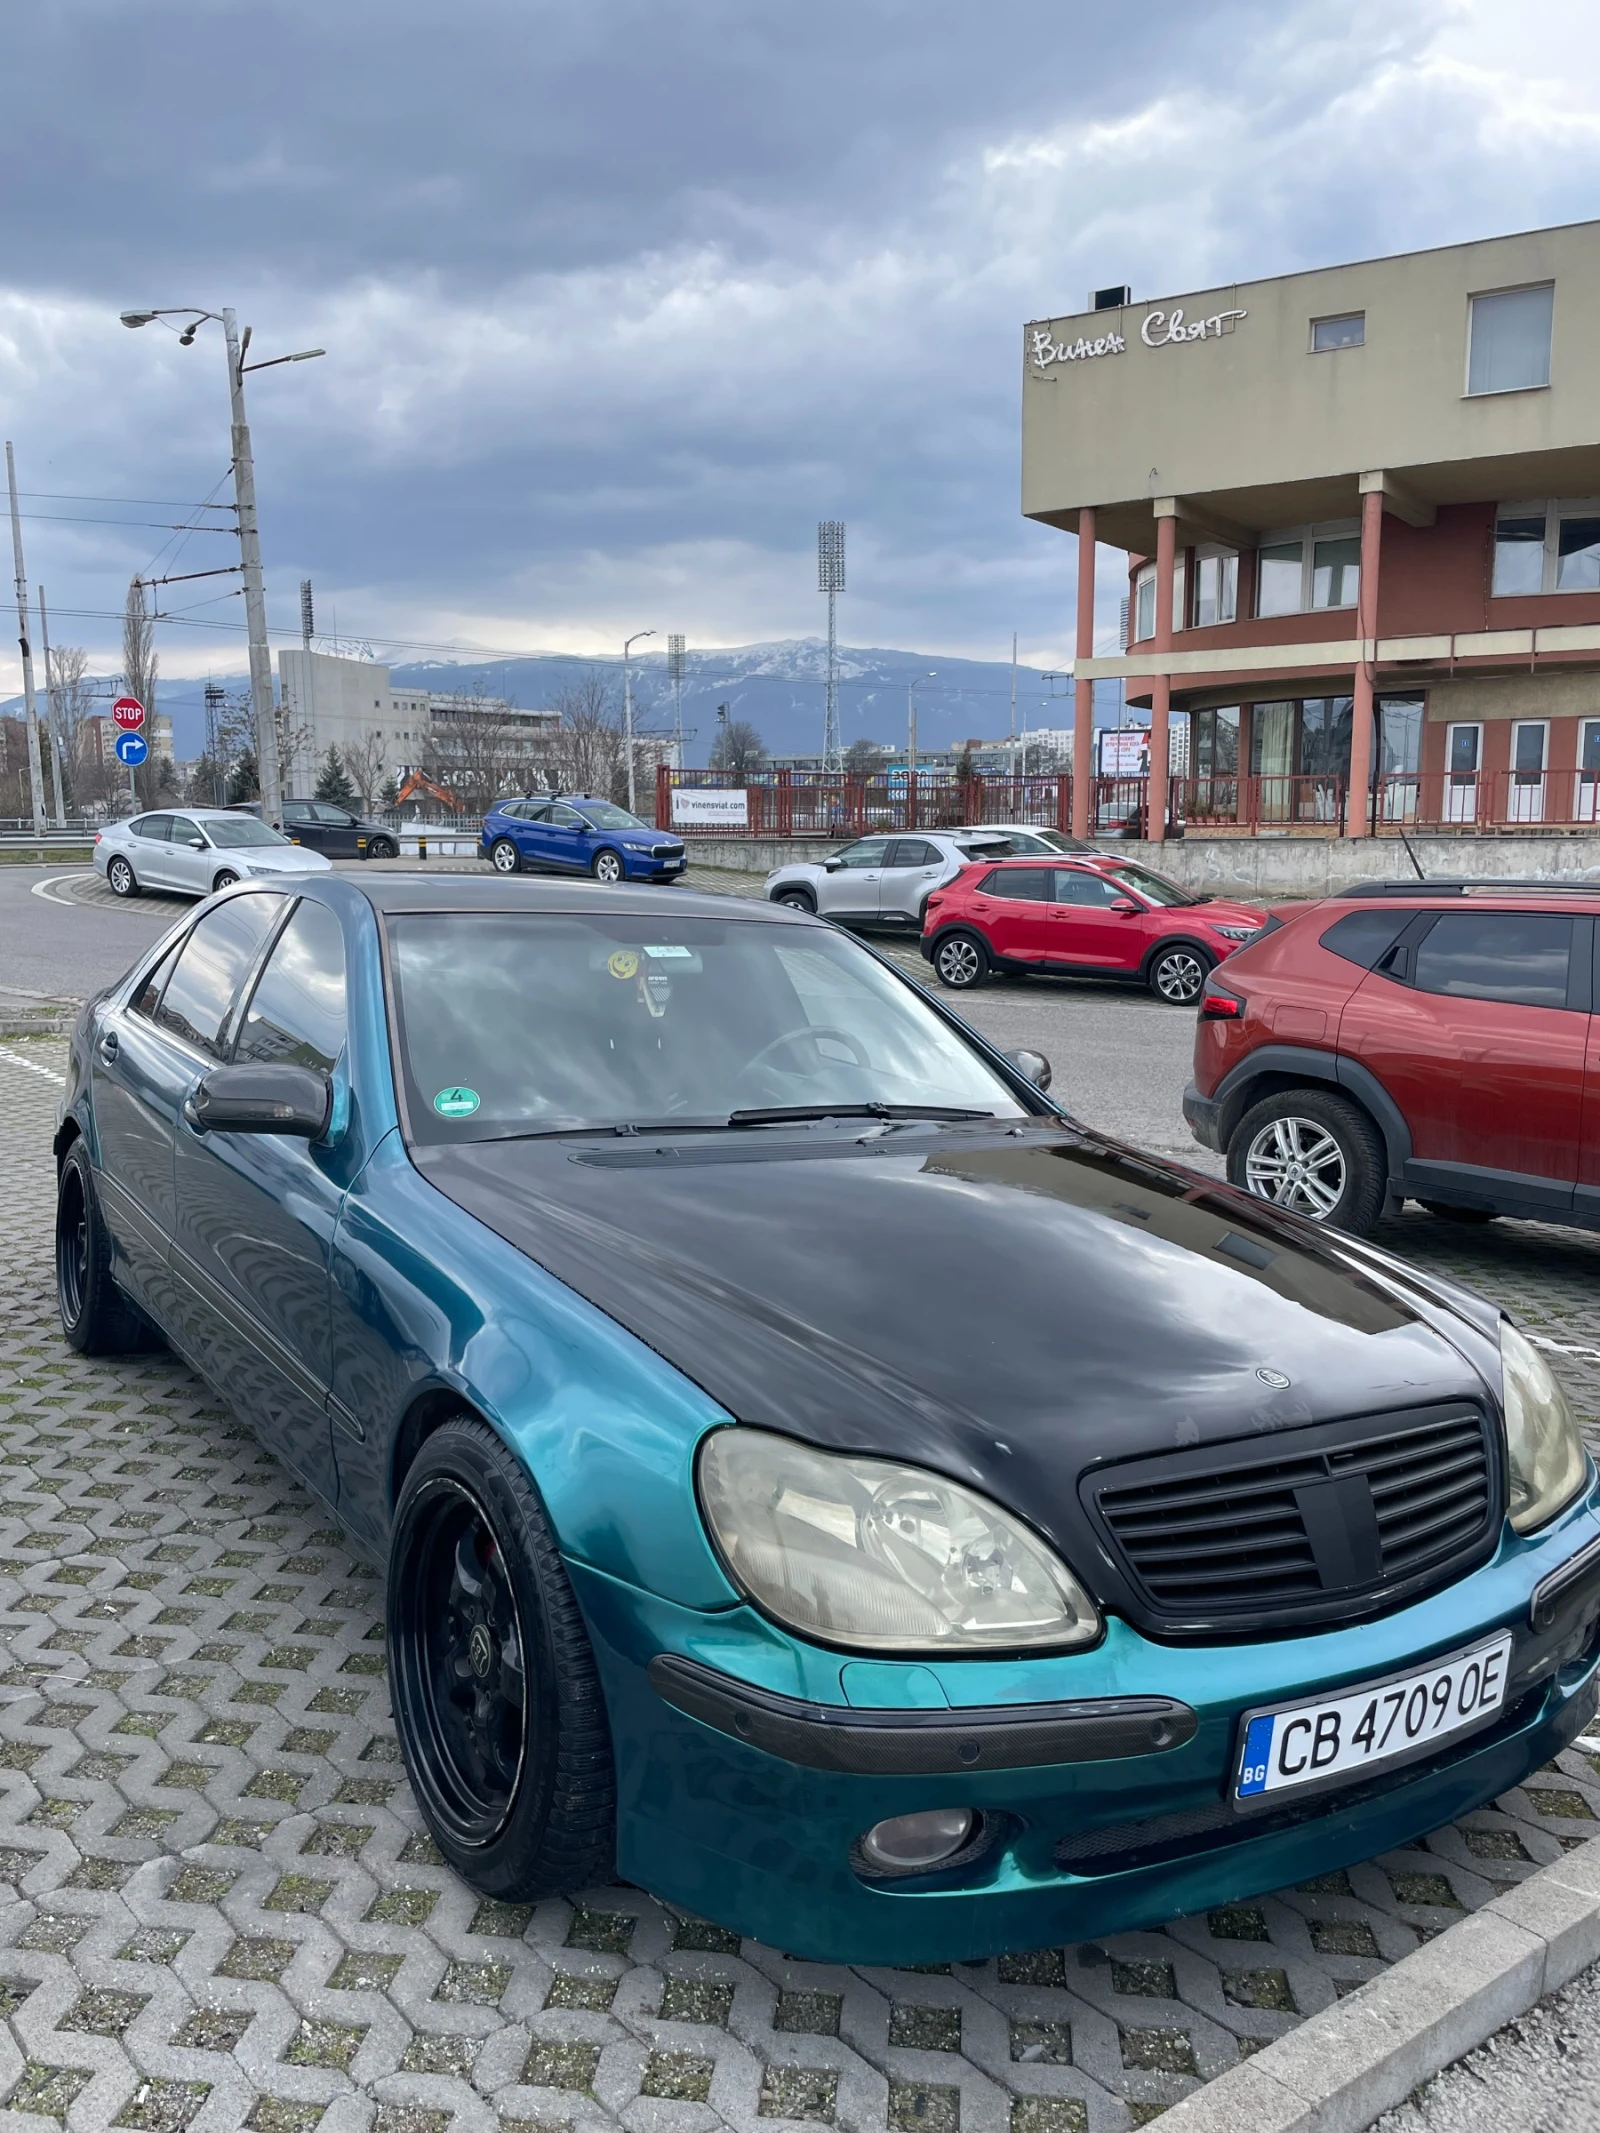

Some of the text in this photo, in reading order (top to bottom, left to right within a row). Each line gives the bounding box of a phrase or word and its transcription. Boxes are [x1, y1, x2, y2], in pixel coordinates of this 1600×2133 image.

[1032, 309, 1247, 369] Винен Свят
[115, 706, 142, 720] STOP
[450, 1089, 463, 1102] 4
[1278, 1649, 1504, 1776] CB 4709 OE
[1242, 1764, 1265, 1785] BG
